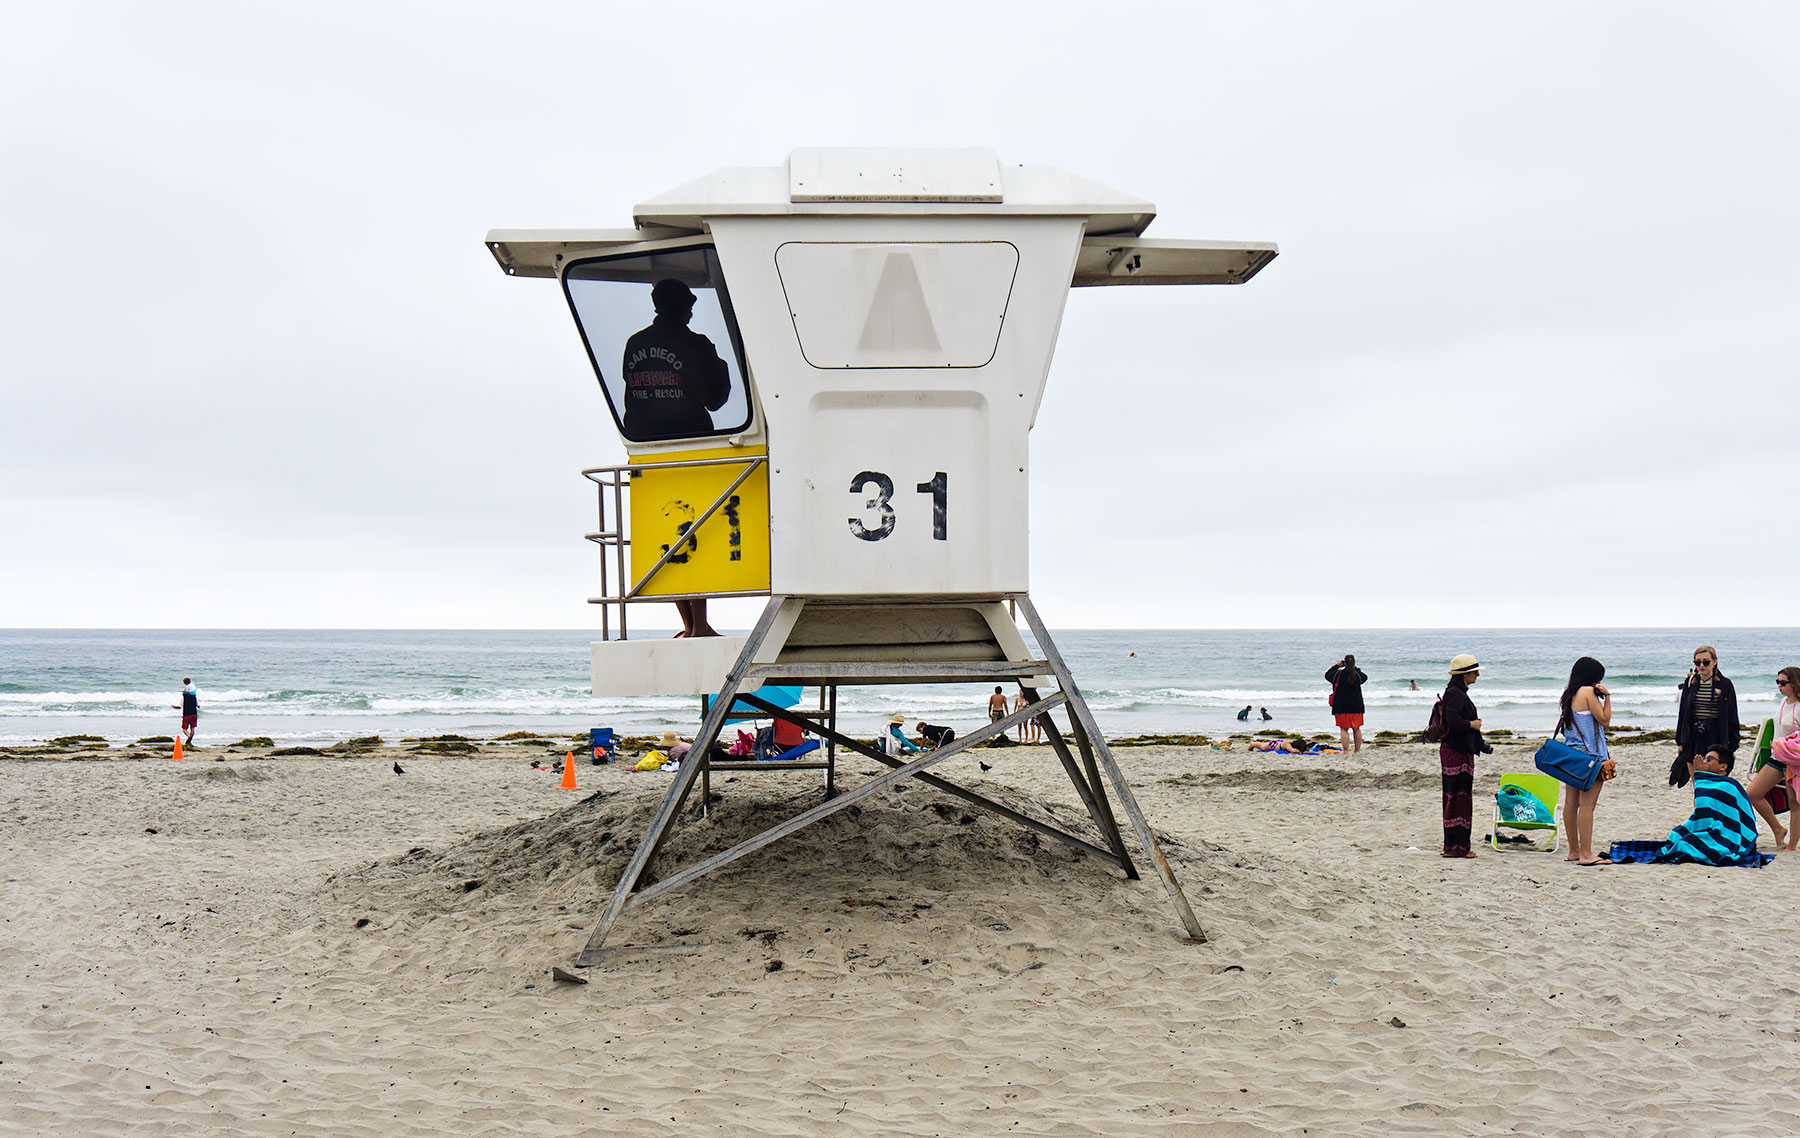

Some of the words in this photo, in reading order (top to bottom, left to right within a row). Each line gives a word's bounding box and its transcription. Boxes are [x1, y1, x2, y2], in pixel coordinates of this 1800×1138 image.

[628, 348, 648, 369] SAN
[650, 347, 683, 370] DIEGO
[628, 371, 682, 387] LIFEGUAR
[848, 470, 947, 541] 31
[660, 495, 741, 564] 31
